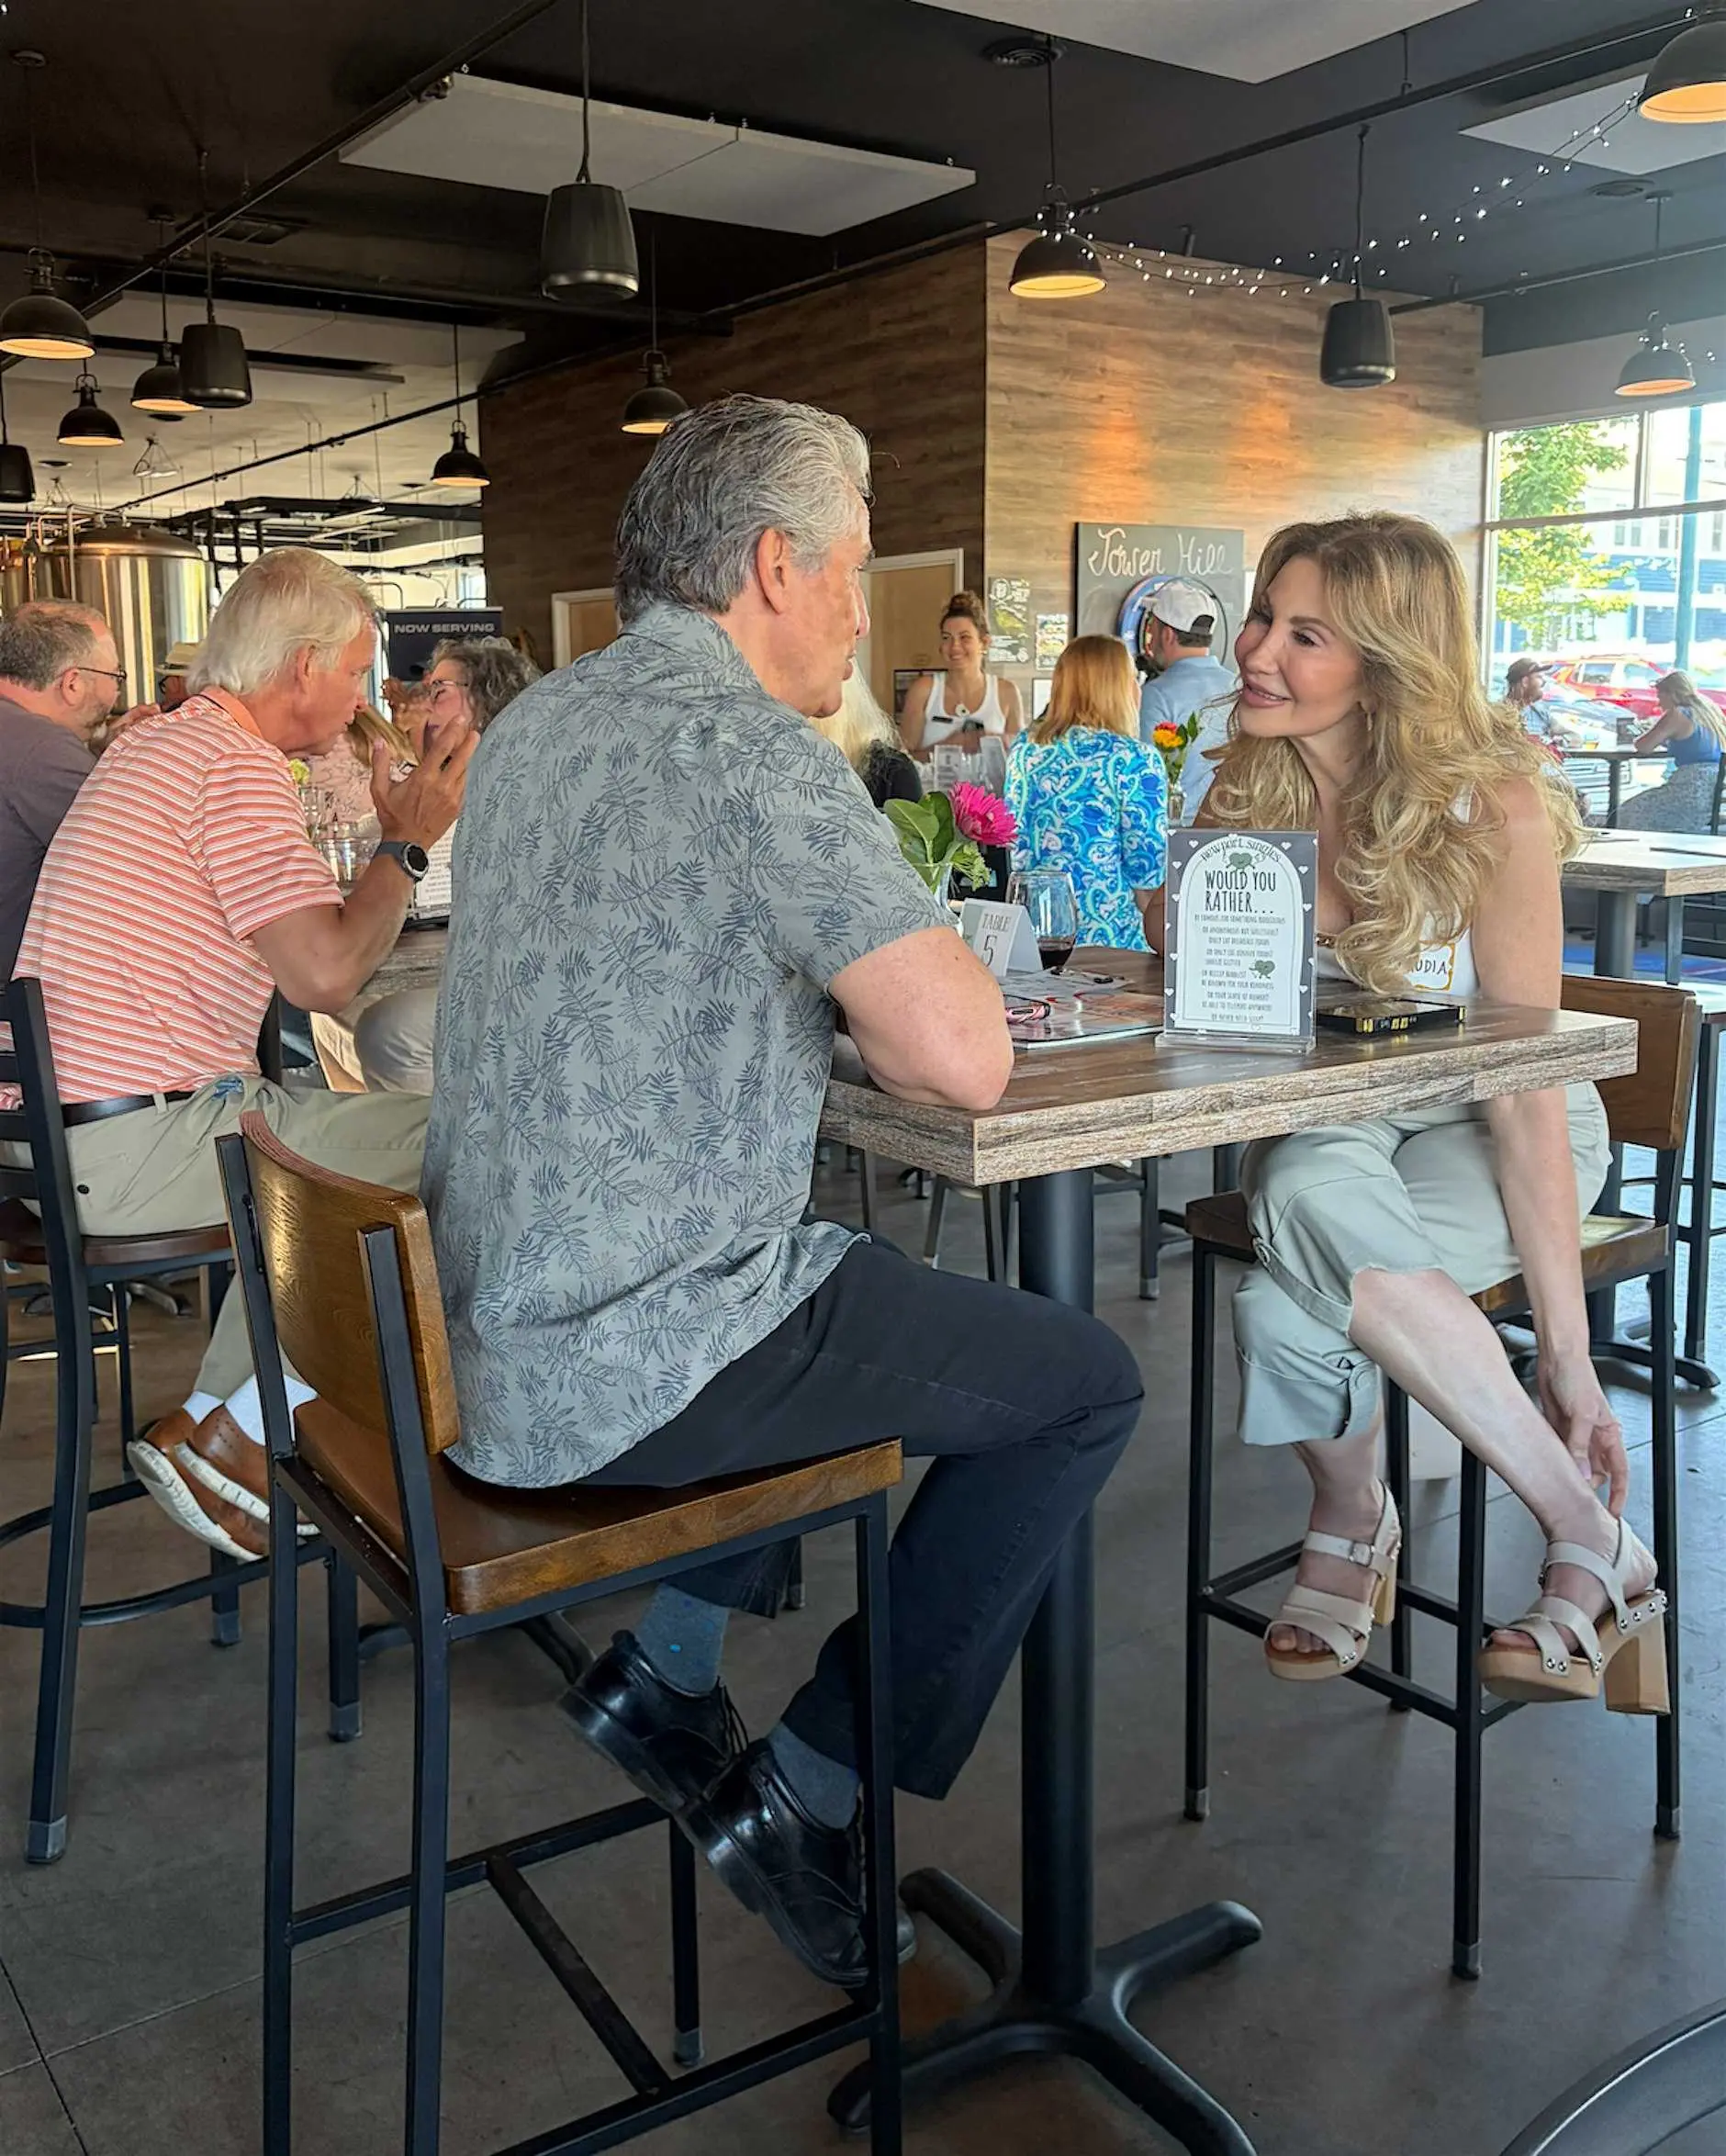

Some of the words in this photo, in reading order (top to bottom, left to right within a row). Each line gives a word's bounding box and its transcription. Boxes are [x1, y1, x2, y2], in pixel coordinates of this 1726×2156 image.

[1177, 533, 1234, 576] Hill
[395, 623, 431, 634] NOW
[432, 623, 495, 634] SERVING
[1205, 870, 1249, 891] WOULD
[1252, 871, 1276, 892] YOU
[982, 913, 1011, 932] TABLE
[981, 935, 997, 967] 5
[1411, 959, 1448, 975] UDIA
